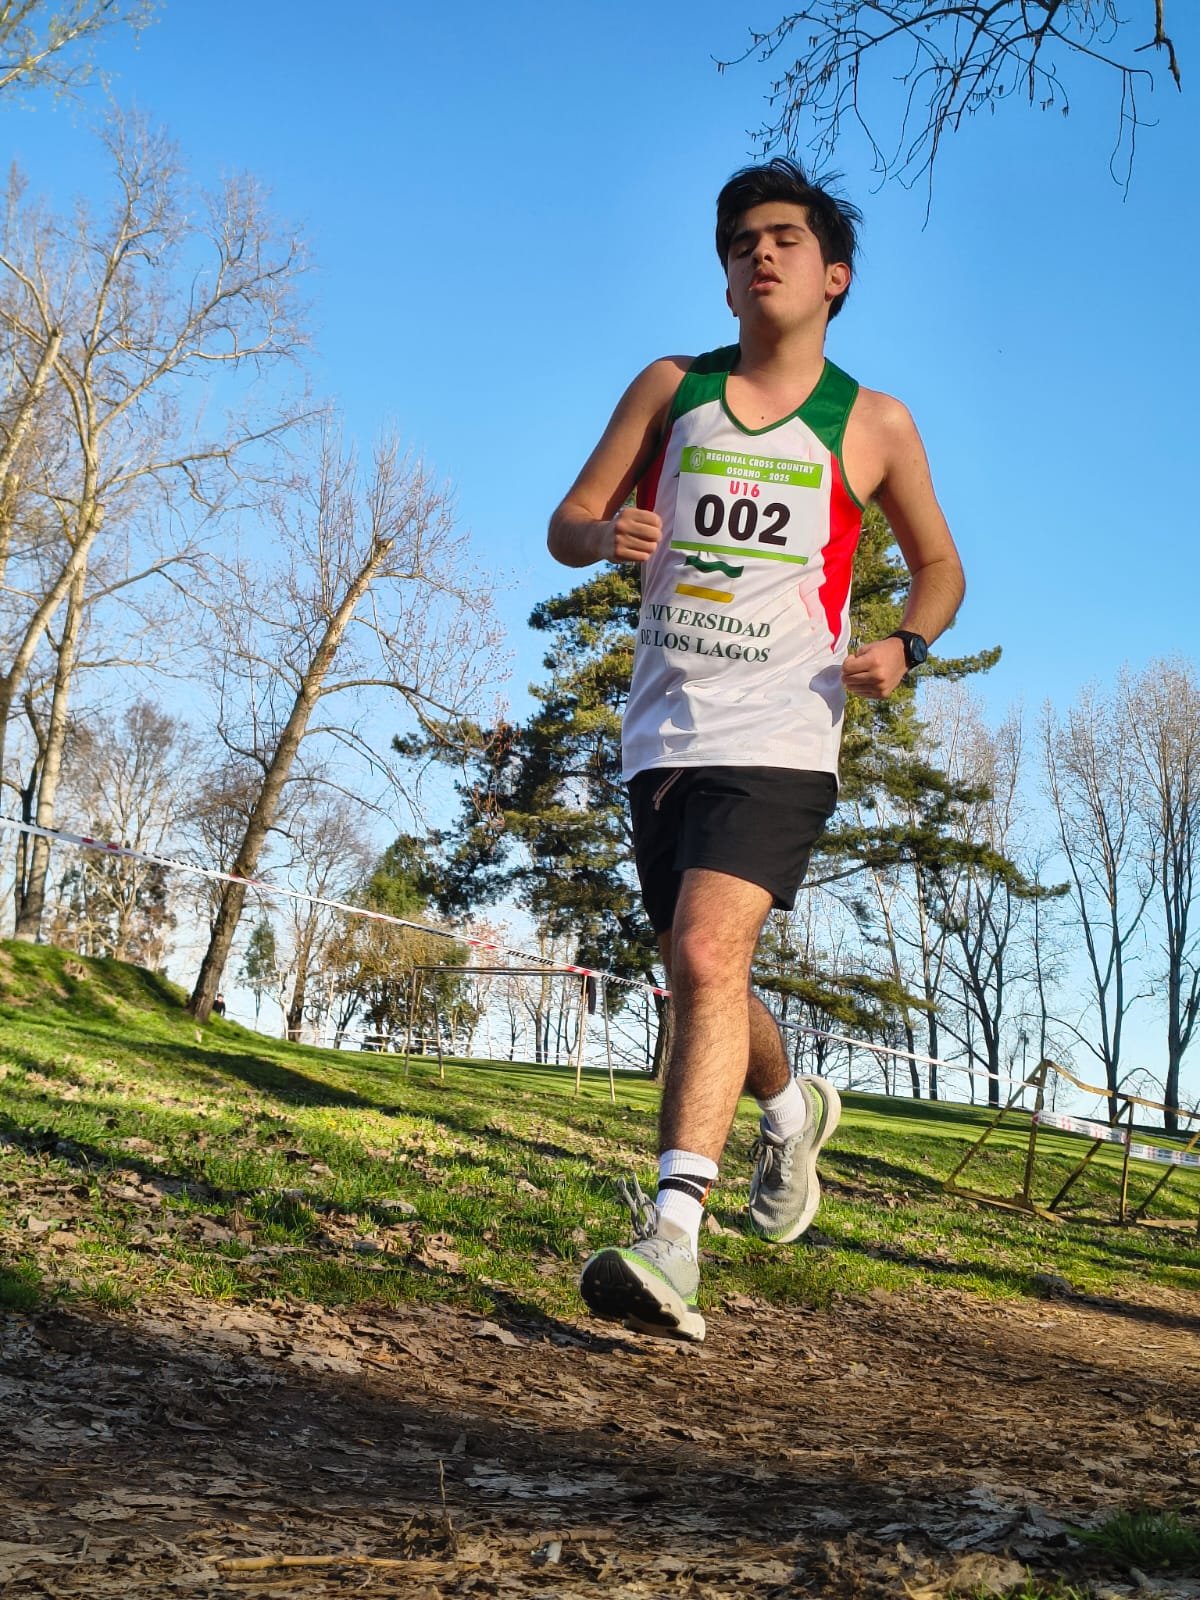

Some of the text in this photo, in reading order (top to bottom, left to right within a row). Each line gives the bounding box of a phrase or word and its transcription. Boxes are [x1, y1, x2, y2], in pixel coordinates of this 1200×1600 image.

[706, 452, 814, 474] REGIONAL CROSS COUNTRY
[726, 466, 760, 479] OSORNO
[769, 473, 790, 482] 2025
[729, 480, 760, 498] U16
[694, 493, 791, 546] 002
[645, 603, 770, 638] NIVERSIDAD
[653, 630, 690, 652] LOS
[695, 637, 771, 663] LAGOS
